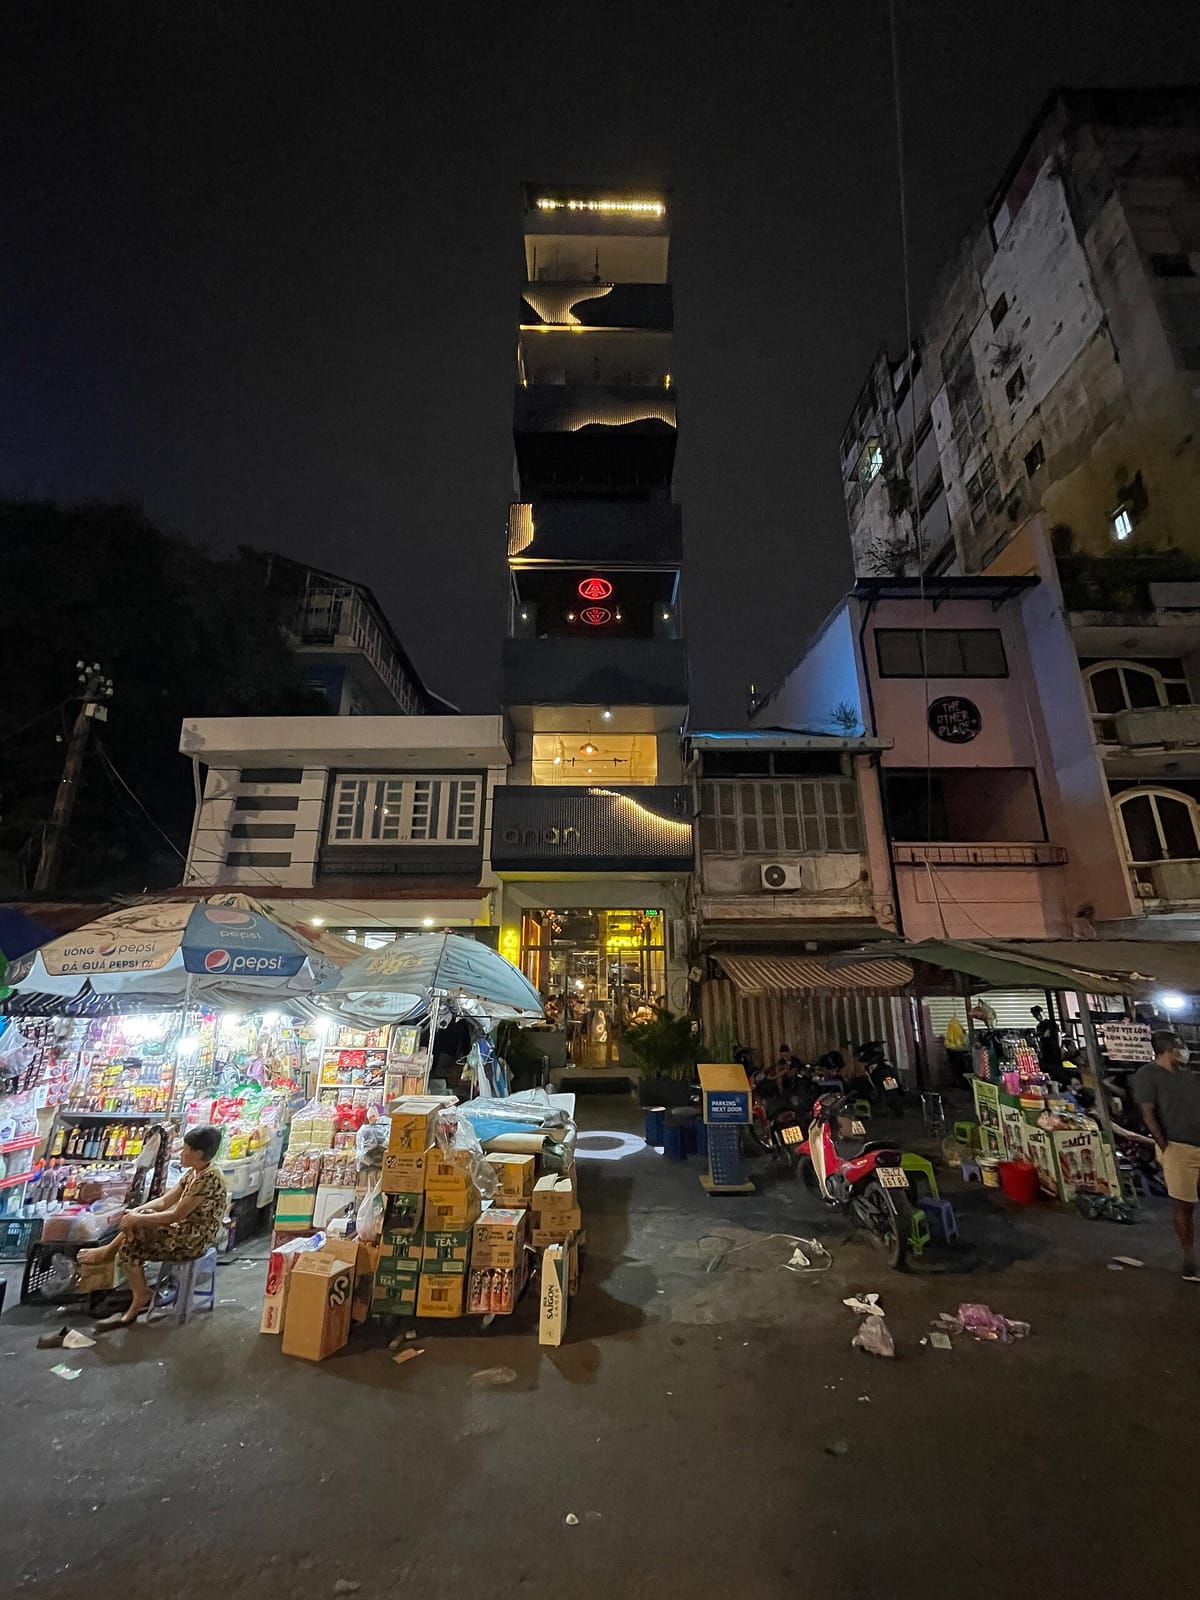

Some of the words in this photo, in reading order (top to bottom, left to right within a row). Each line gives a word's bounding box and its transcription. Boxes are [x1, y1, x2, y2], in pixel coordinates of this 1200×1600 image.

[942, 700, 960, 712] THE
[937, 710, 970, 724] OTHER
[938, 721, 970, 736] PLACE
[219, 929, 263, 939] pepsi
[118, 941, 158, 955] pepsi
[108, 960, 139, 969] PEPSI
[232, 956, 282, 971] pepsi
[386, 1155, 397, 1168] C2
[546, 1284, 555, 1320] SAIGON
